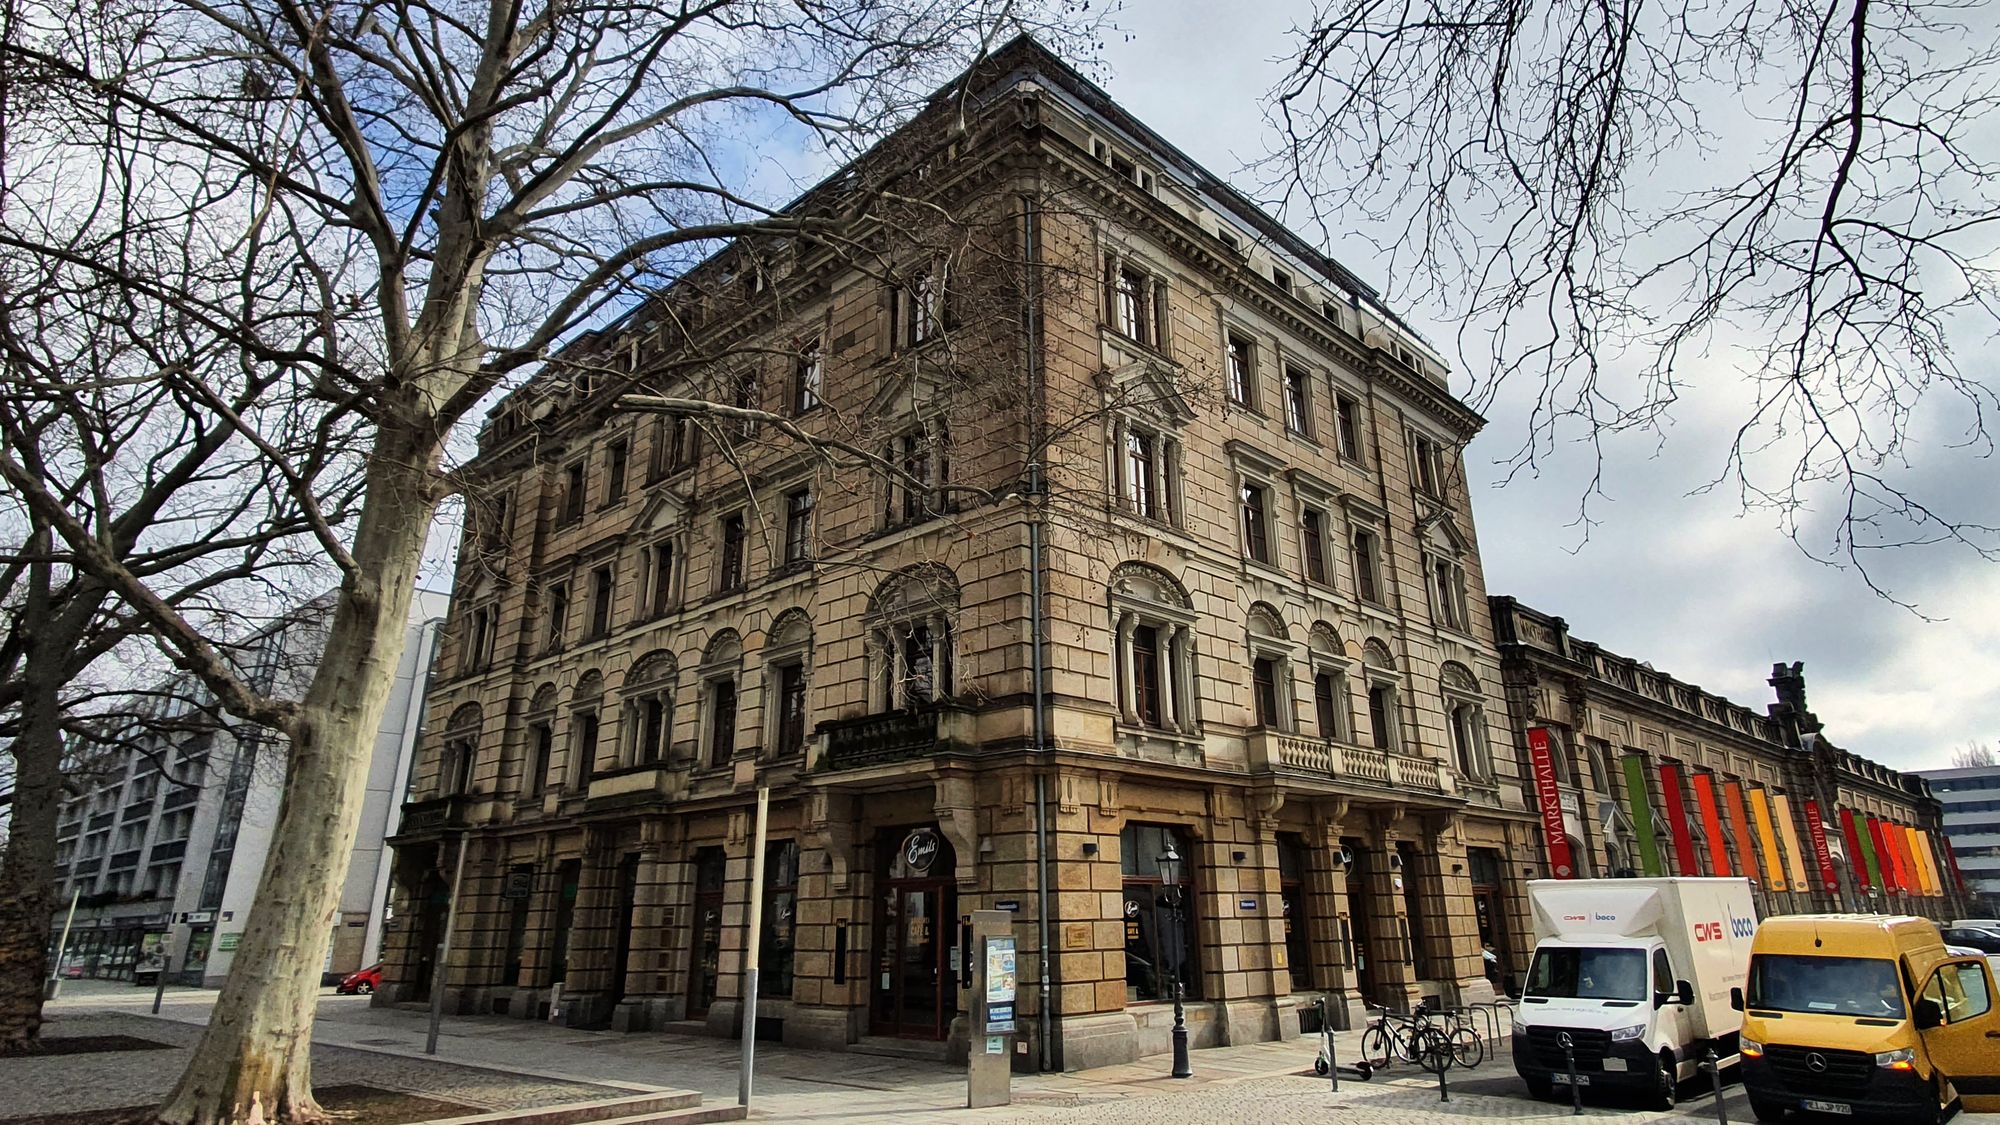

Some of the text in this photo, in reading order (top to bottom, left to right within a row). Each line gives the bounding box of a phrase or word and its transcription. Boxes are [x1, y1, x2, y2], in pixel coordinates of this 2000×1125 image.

[1534, 740, 1565, 844] MARKTHALLE
[906, 834, 936, 864] Emils
[1807, 808, 1832, 870] MARKTHALLE
[1694, 922, 1722, 941] CWS
